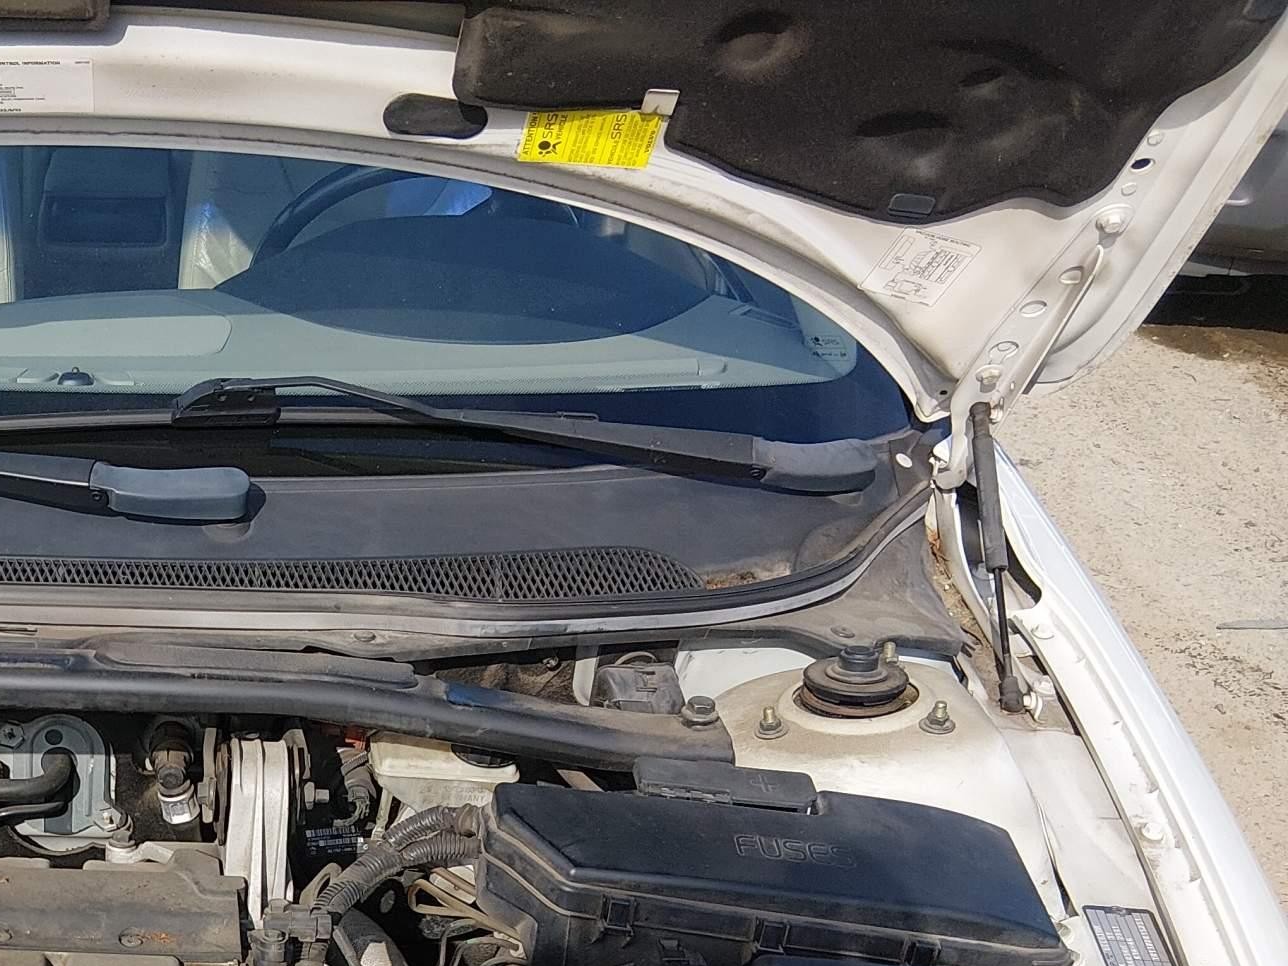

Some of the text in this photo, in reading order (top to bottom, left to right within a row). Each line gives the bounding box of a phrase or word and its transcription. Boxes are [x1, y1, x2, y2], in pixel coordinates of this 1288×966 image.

[521, 116, 539, 155] ATTENTION
[542, 113, 558, 139] SRS
[555, 114, 569, 143] VEHICLE
[611, 114, 627, 140] SRS
[734, 833, 856, 869] FUSES
